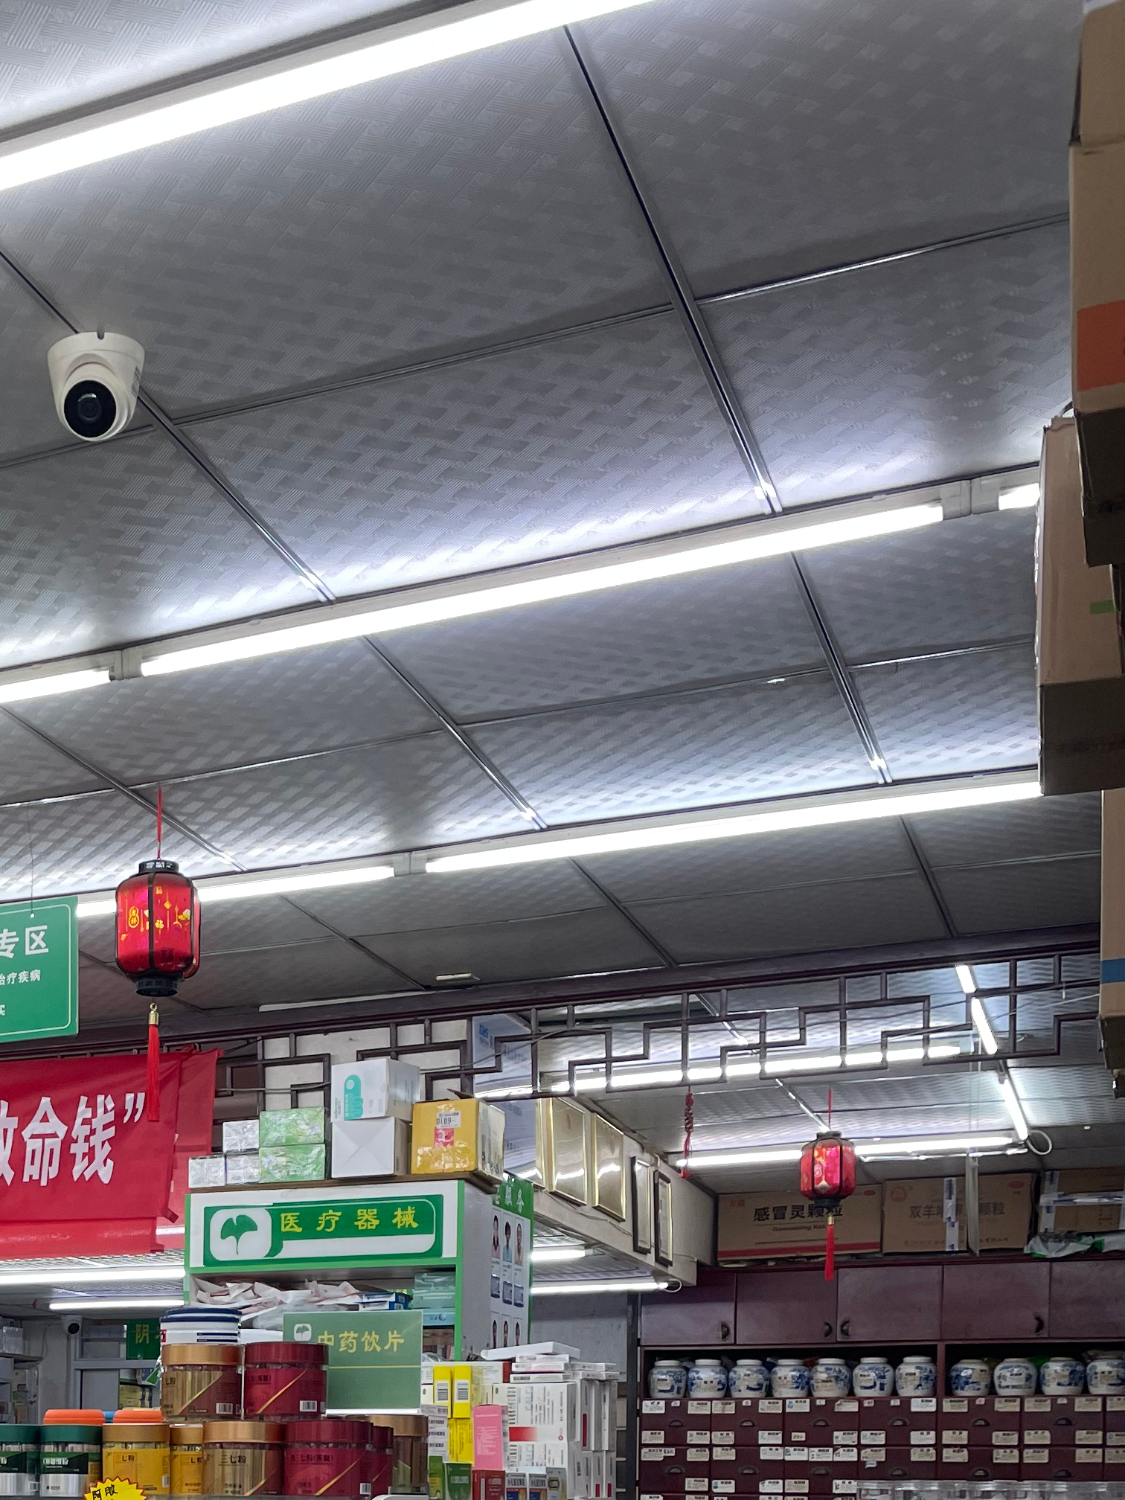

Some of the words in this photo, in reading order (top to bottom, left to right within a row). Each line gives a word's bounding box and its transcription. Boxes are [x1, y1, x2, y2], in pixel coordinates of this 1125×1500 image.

[280, 1205, 419, 1233] 医疗器械
[753, 1203, 843, 1223] 感冒灵颗粒
[316, 1323, 405, 1353] 中药饮片
[219, 1454, 246, 1464] 三七粉
